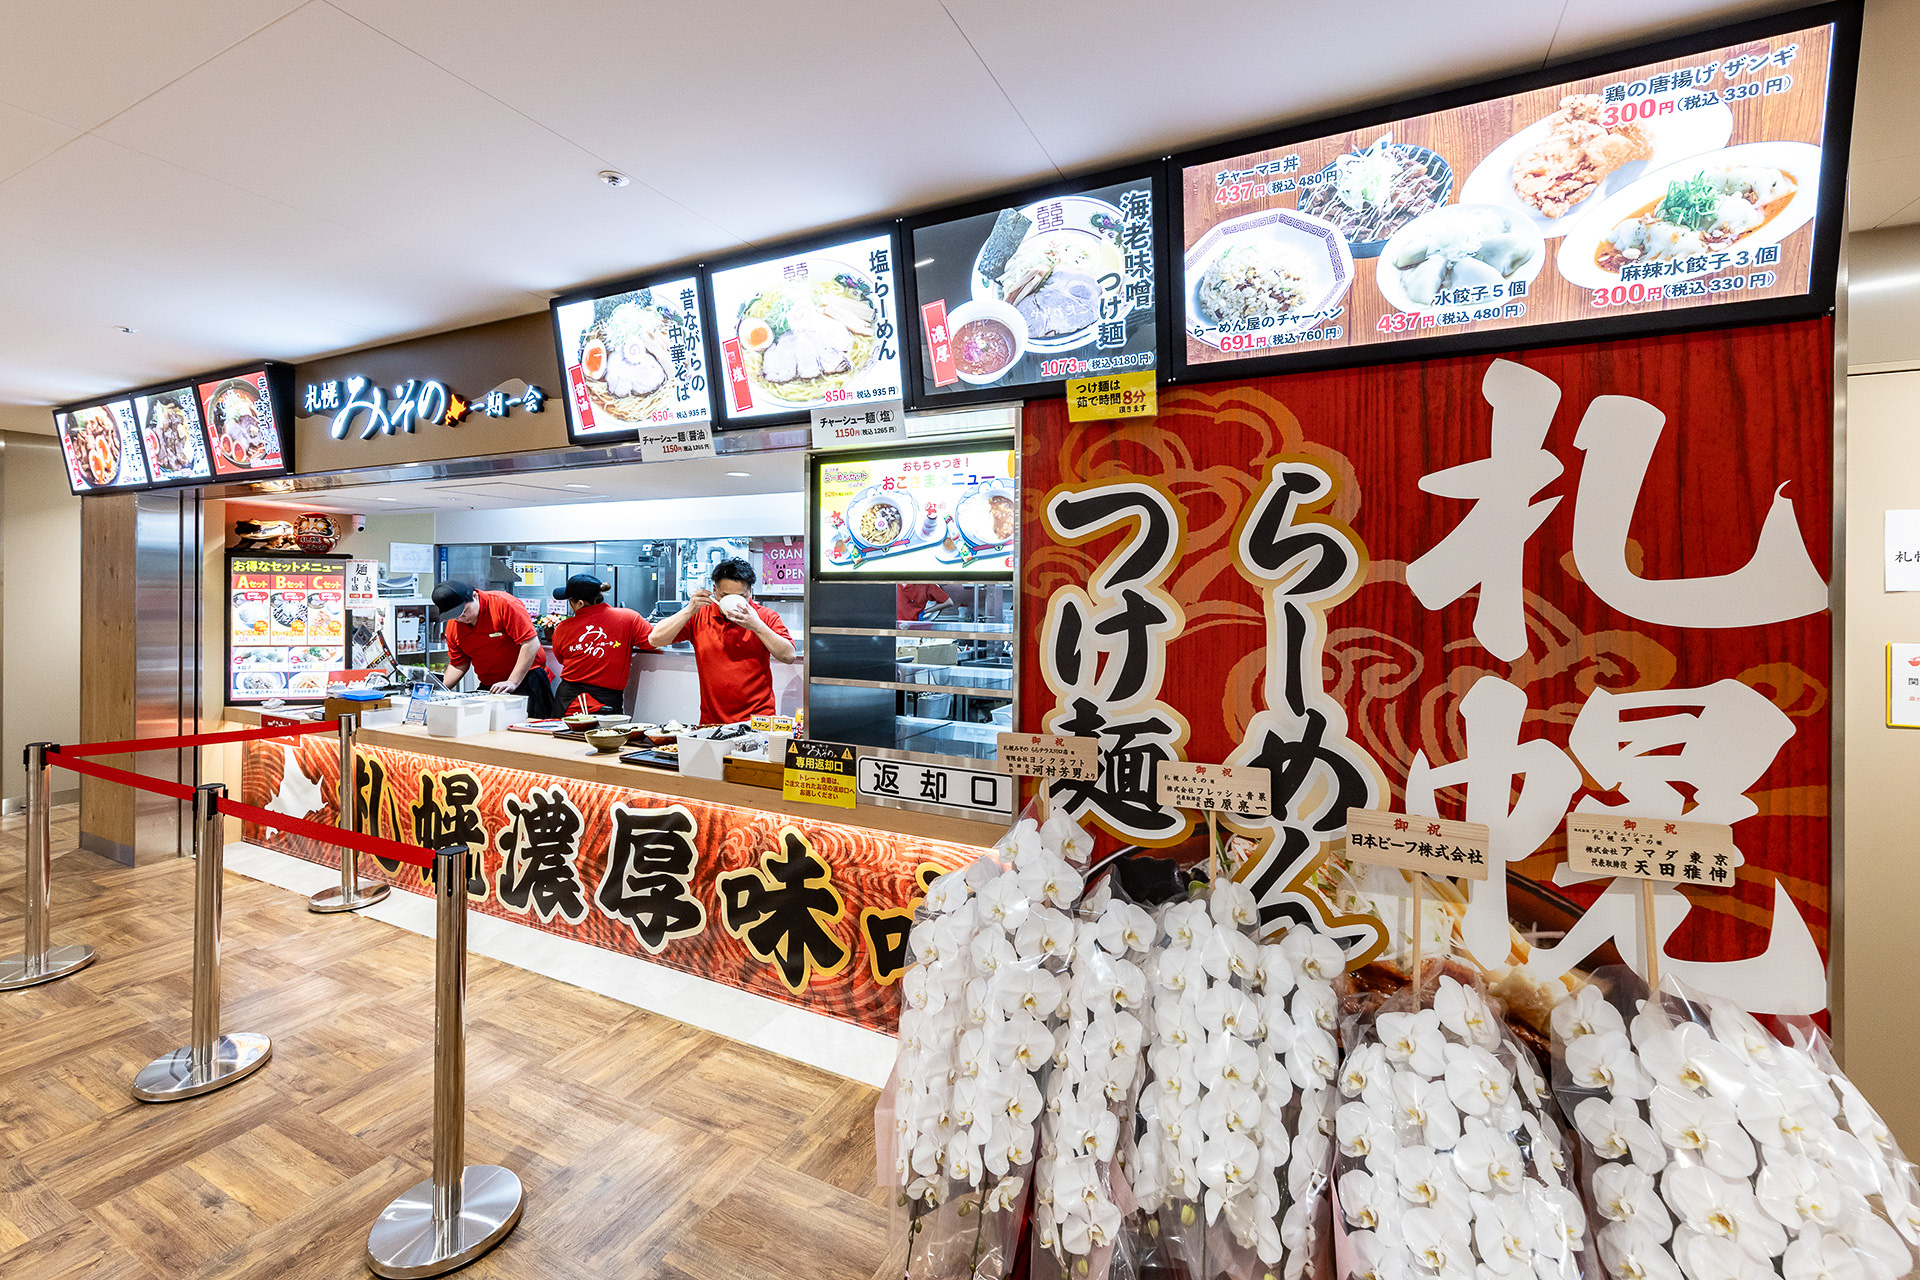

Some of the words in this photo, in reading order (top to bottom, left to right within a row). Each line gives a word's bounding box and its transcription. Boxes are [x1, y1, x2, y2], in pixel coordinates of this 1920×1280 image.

[1605, 63, 1718, 104] 鶏の唐揚げ
[1724, 45, 1796, 77] ザンギ
[1217, 155, 1299, 185] チャーマヨ丼
[1121, 191, 1152, 308] 海老味噌
[869, 249, 896, 361] 塩らーめん
[1097, 272, 1124, 348] つけ麺
[1193, 307, 1343, 337] らーめん屋のチャーハン
[679, 287, 705, 391] 昔ながらの
[668, 324, 690, 402] 中華そば
[1076, 380, 1121, 393] つけ麺は
[304, 380, 339, 412] 札幌
[331, 375, 446, 439] みその
[469, 385, 542, 416] 一期一会
[1119, 404, 1147, 414] 頂きます
[820, 409, 895, 428] チャーシュー麺（塩）
[882, 473, 996, 491] おこさまメニュー
[233, 560, 344, 573] お得なセットメニュー
[355, 563, 368, 576] 麺
[237, 575, 268, 589] Aセット
[275, 575, 305, 589] Bセット
[312, 575, 341, 589] Cセット
[1050, 492, 1178, 830] つけ麺
[795, 757, 844, 773] 専用返却口
[800, 789, 839, 800] お返しください
[873, 762, 997, 807] 返却口
[1203, 797, 1268, 813] 西原亮一
[1393, 818, 1442, 837] 御祝
[1623, 819, 1678, 835] 御祝
[1351, 833, 1485, 865] 日本ビーフ株式会社
[341, 750, 940, 986] 札幌濃厚味
[1634, 859, 1728, 883] 天田雅伸
